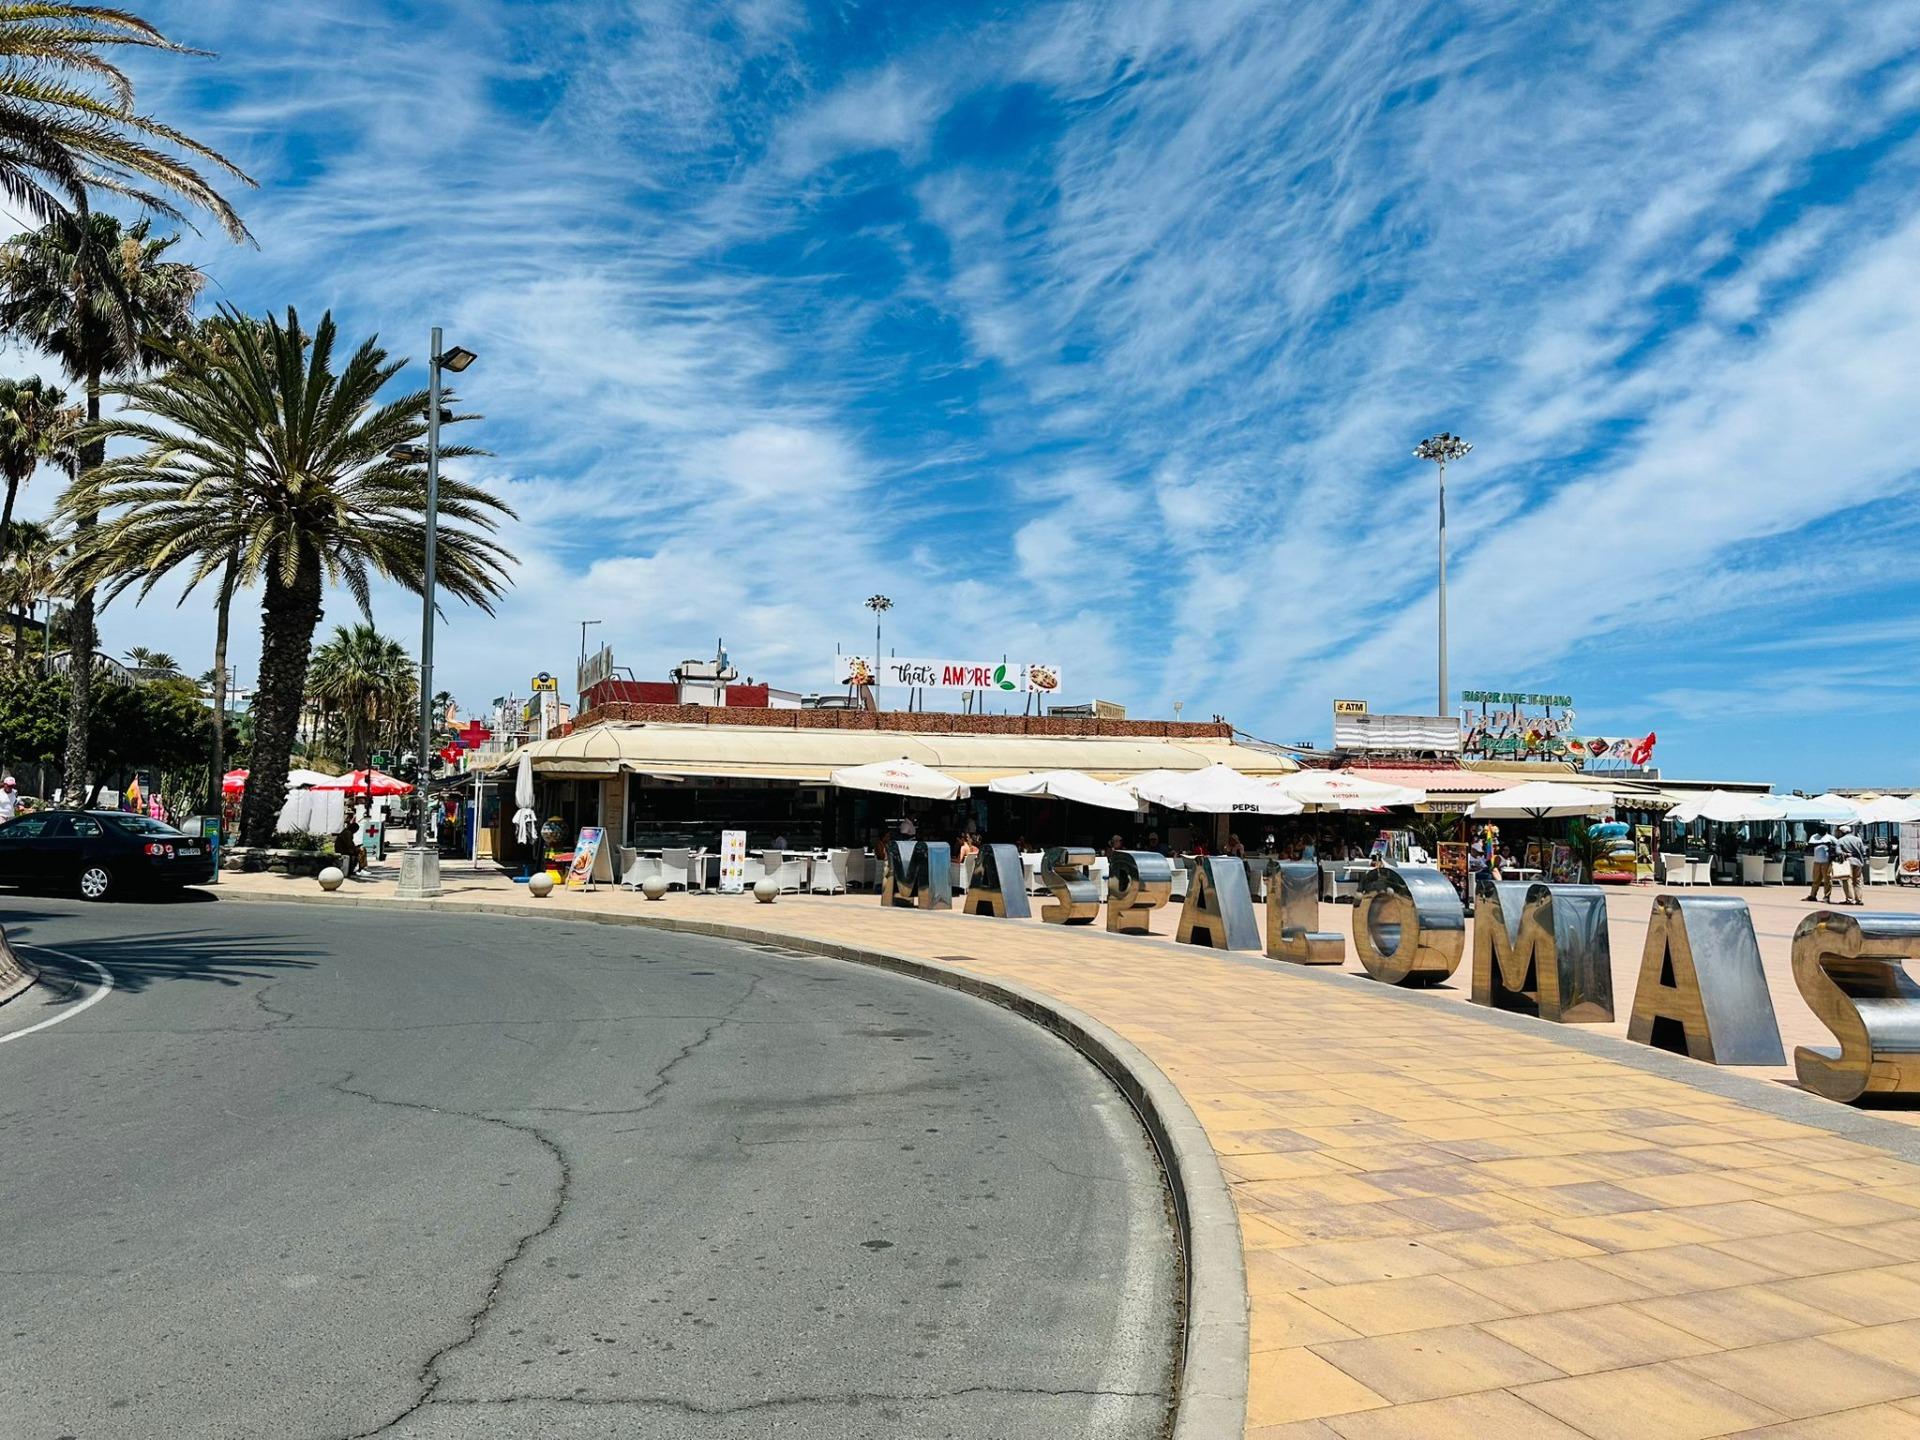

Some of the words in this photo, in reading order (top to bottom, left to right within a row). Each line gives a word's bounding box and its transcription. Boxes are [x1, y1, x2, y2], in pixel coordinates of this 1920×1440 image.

[890, 662, 937, 687] that's
[1462, 690, 1526, 704] RISTORANTE
[1528, 694, 1572, 707] ITALIANO
[1345, 703, 1364, 711] ATM
[470, 753, 491, 764] ATM
[880, 782, 910, 790] VICTORIA
[1232, 803, 1260, 812] PEPSI
[881, 840, 1920, 1102] MASPALOMAS
